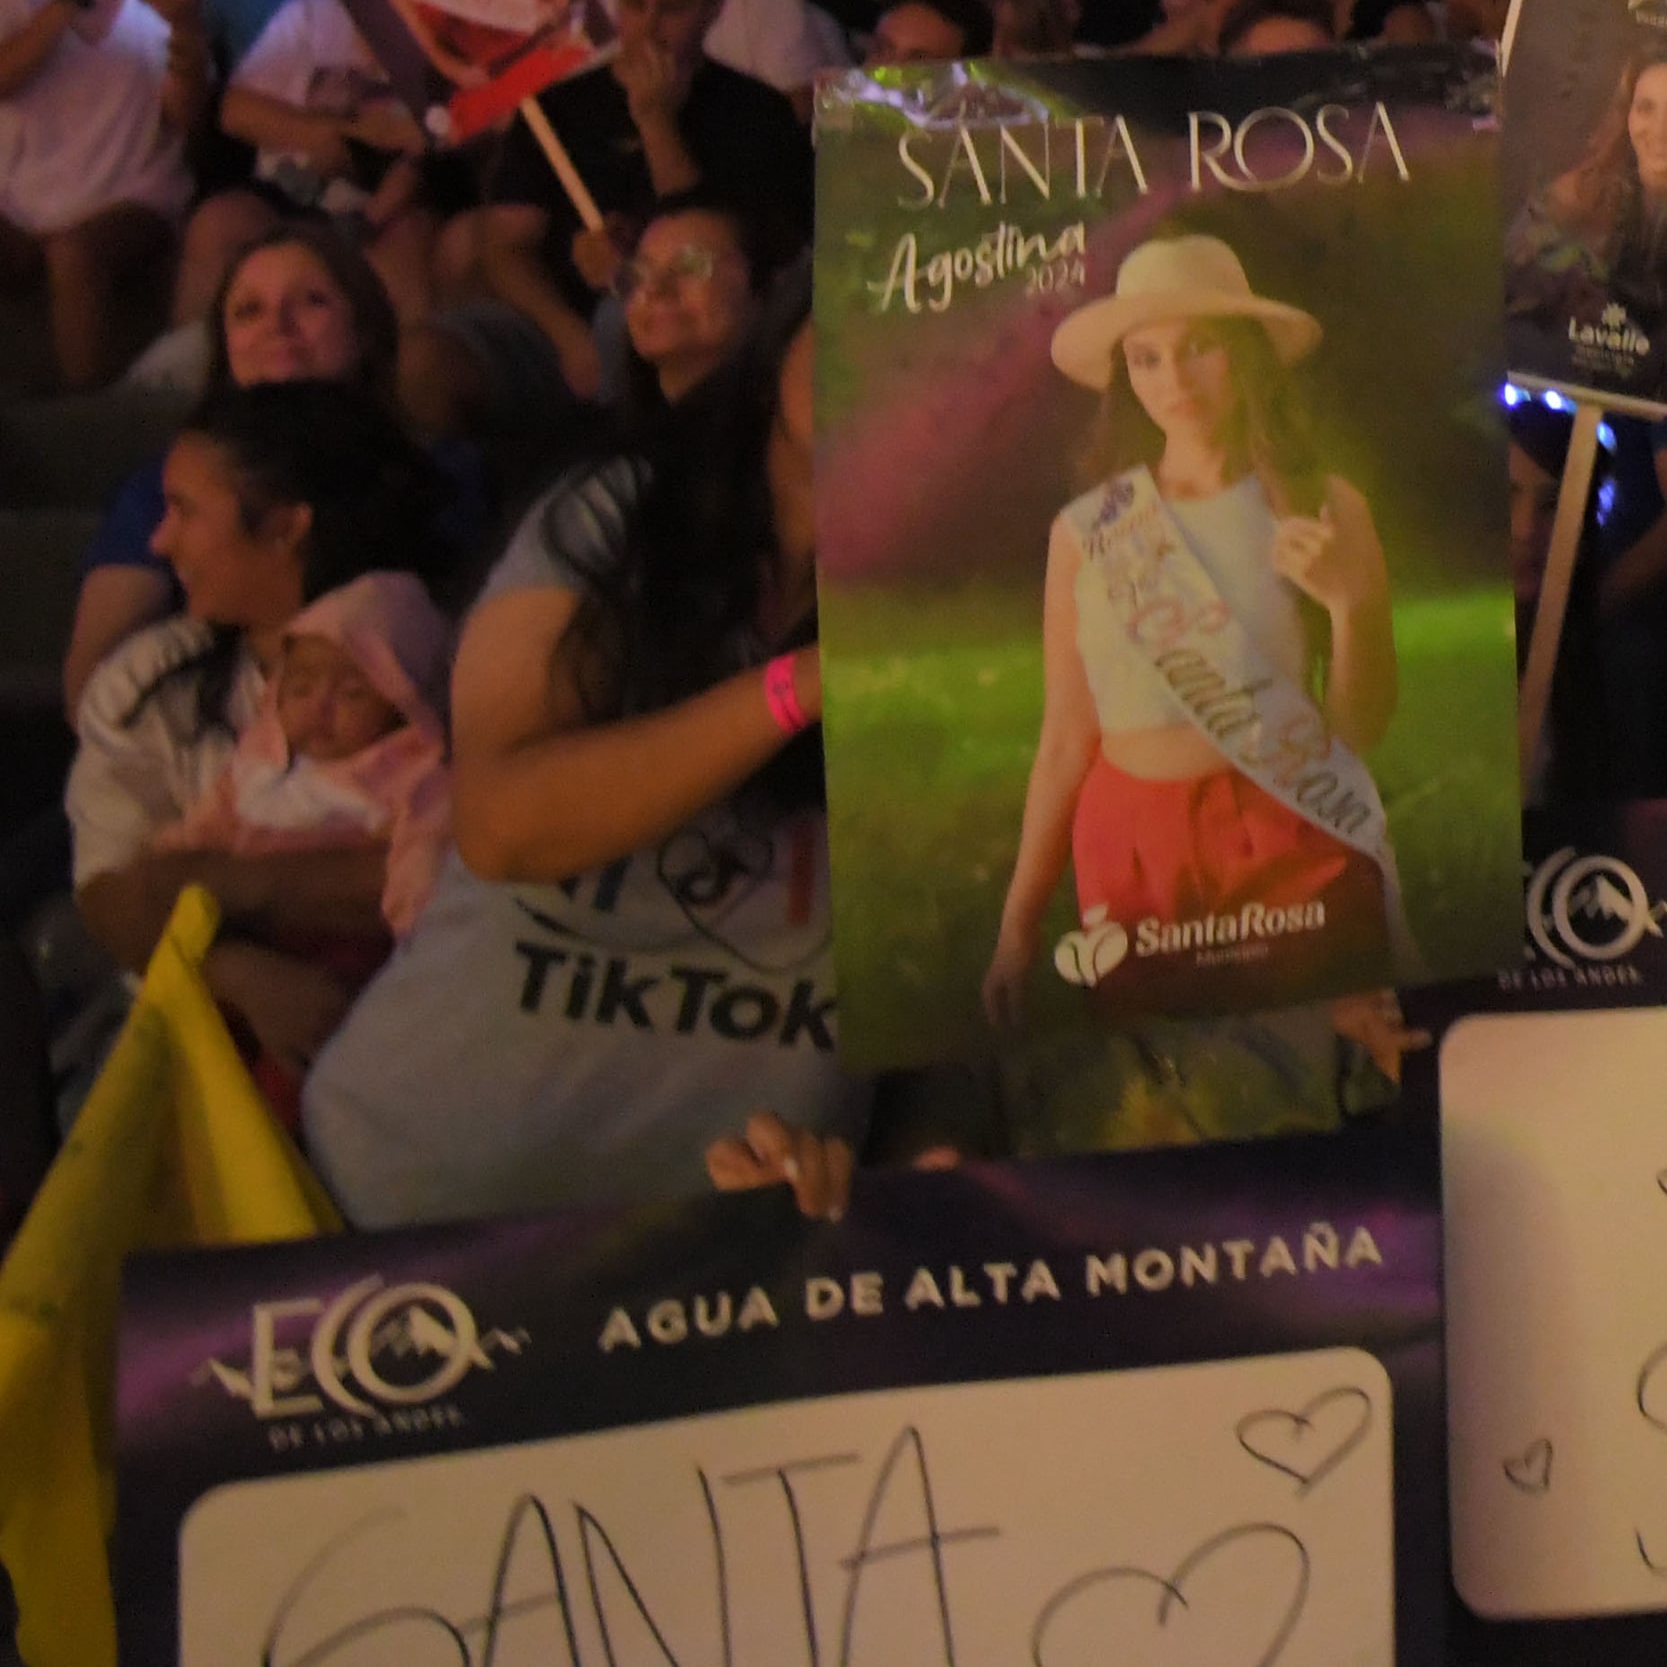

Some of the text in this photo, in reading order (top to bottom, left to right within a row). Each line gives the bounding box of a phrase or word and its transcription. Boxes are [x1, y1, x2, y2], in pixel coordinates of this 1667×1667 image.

[897, 101, 1411, 210] SANTA ROSA
[866, 220, 1086, 315] Agostina
[1024, 258, 1086, 297] 2024
[1568, 316, 1651, 356] Lavalle
[1135, 900, 1328, 958] SantaRosa
[1523, 846, 1650, 971] CO
[515, 939, 838, 1055] TikTok
[597, 1216, 1386, 1355] AGUA DE ALTA MONTAÑA
[251, 1273, 479, 1421] ECO
